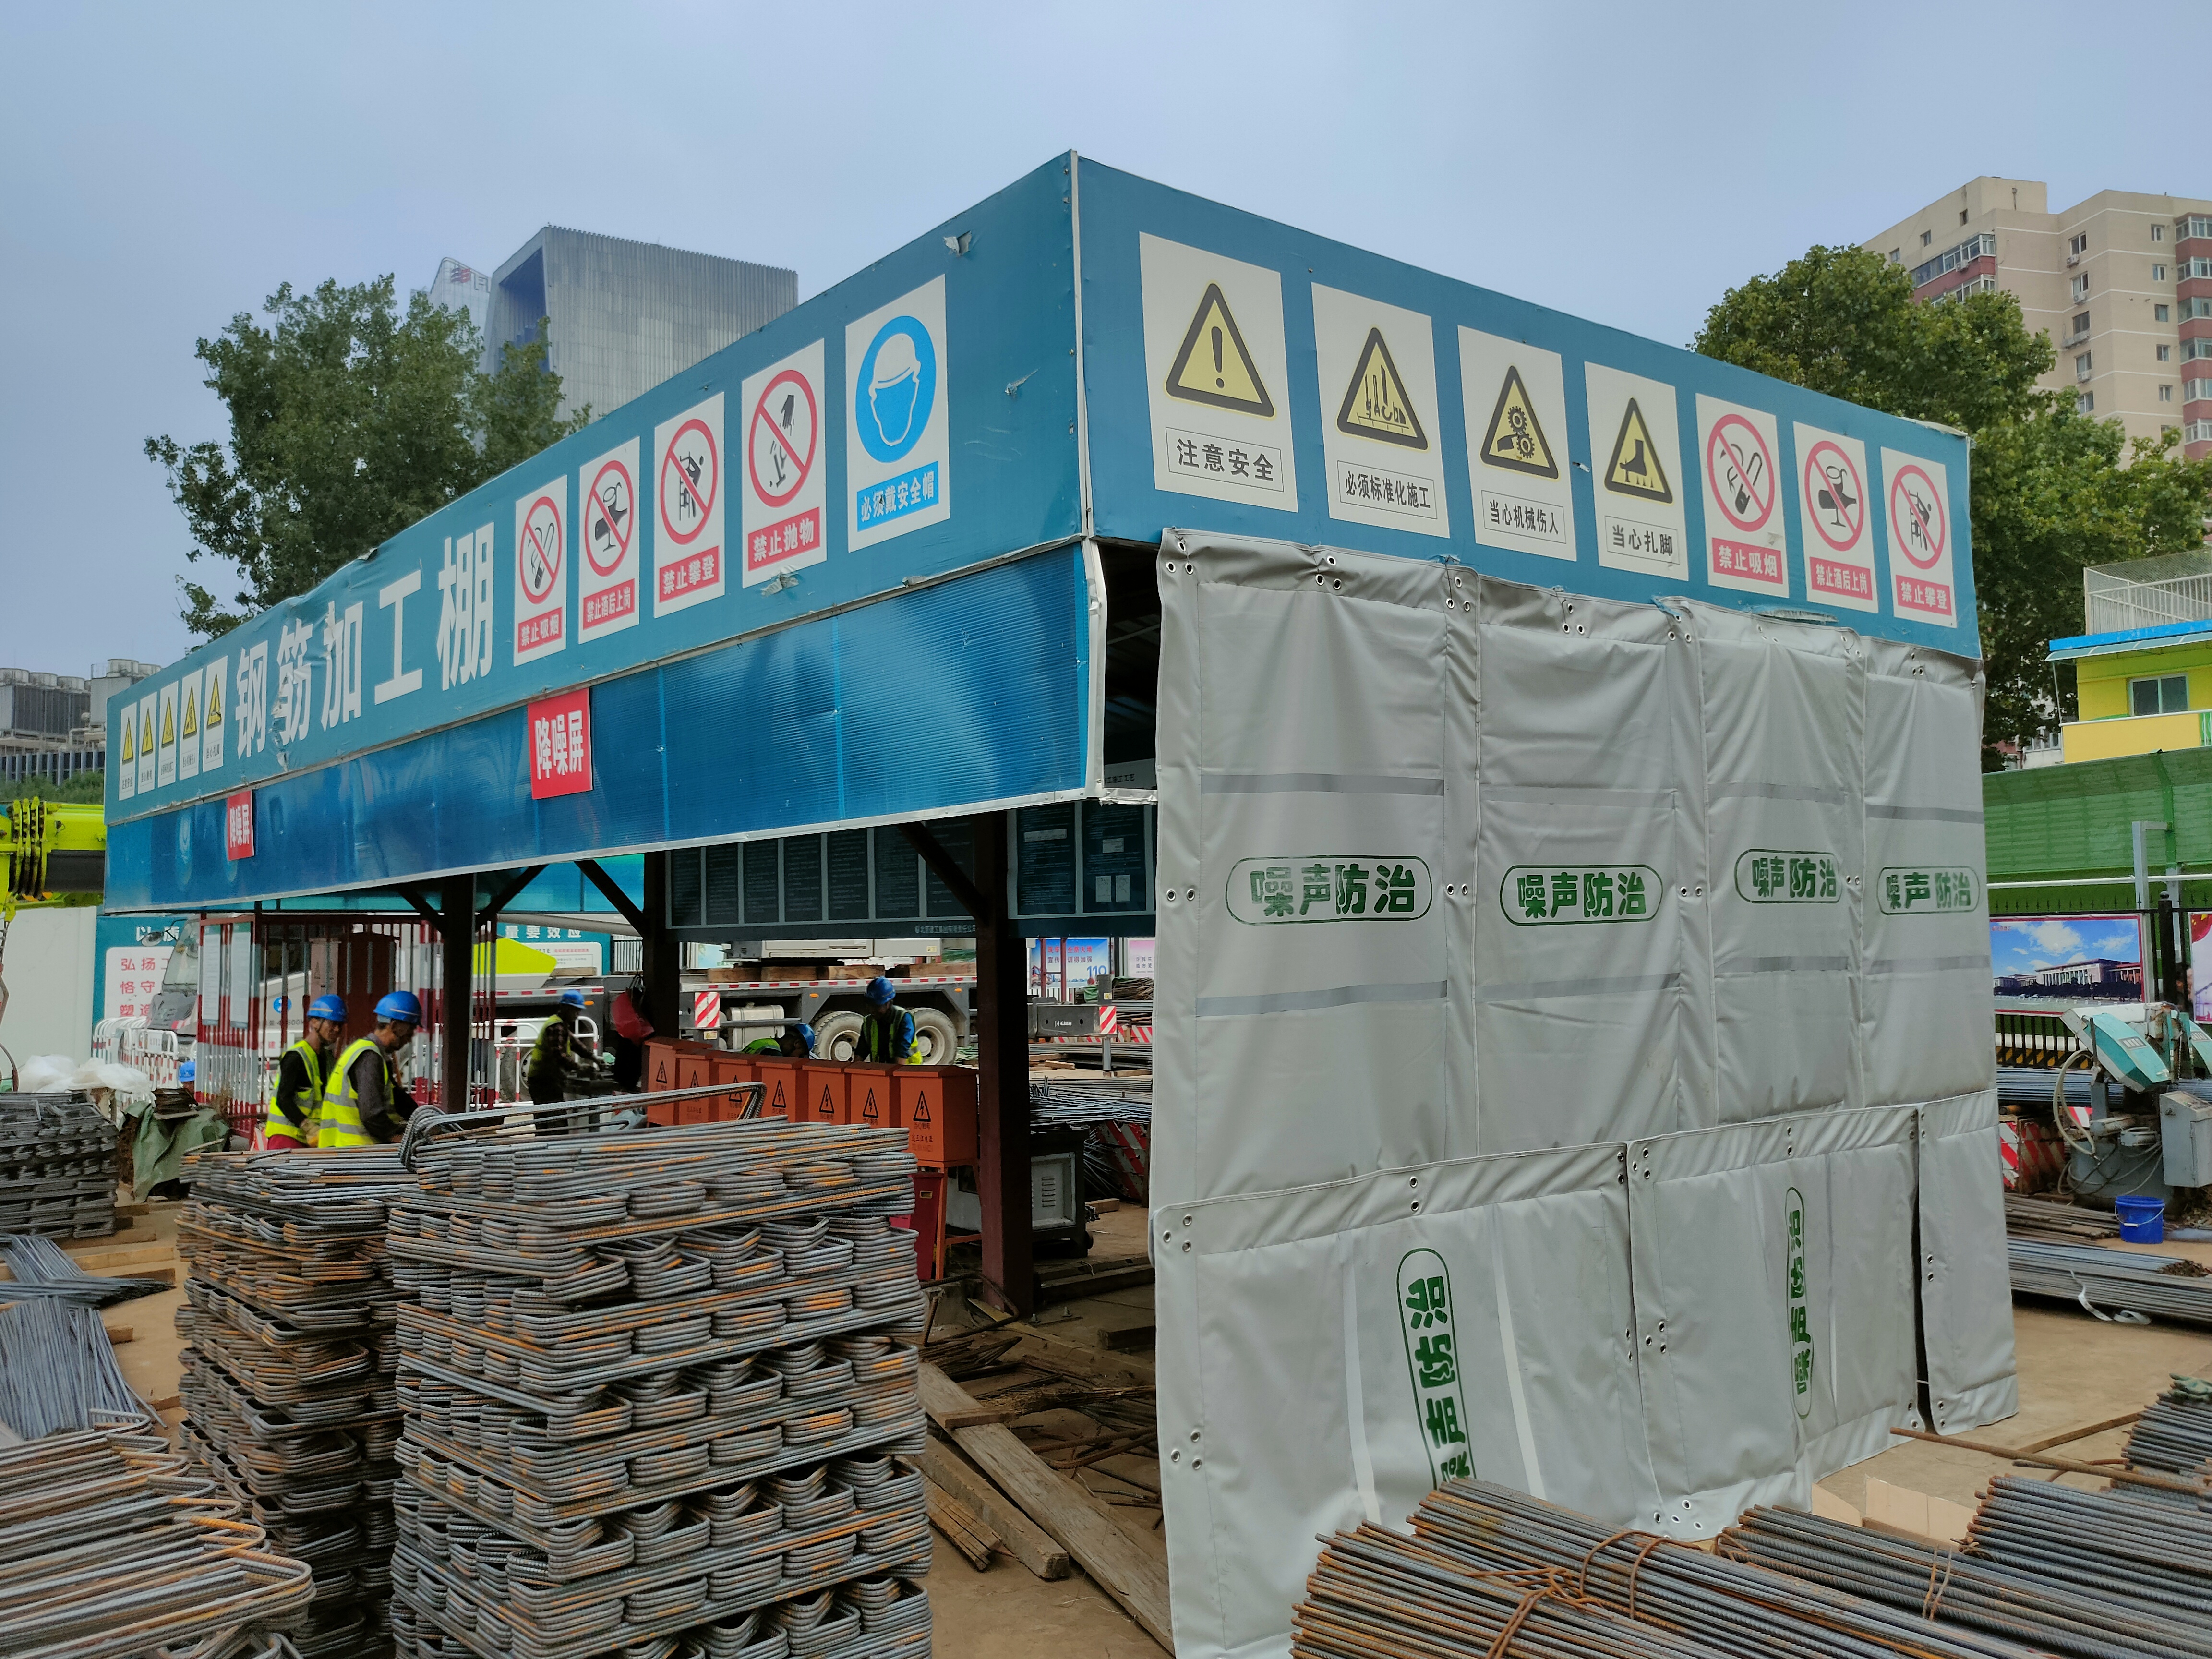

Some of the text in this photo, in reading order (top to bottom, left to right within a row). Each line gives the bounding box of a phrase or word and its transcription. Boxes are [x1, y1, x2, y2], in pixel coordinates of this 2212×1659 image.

[1177, 438, 1274, 482] 注意安全
[861, 470, 935, 522] 必须戴安全帽
[1345, 470, 1431, 510] 必须标准化施工
[1489, 499, 1560, 536] 当心机械伤人
[752, 518, 815, 563] 禁止抛物
[1611, 524, 1674, 557] 当心扎脚
[1718, 544, 1778, 578] 禁止吸烟
[662, 554, 715, 595] 禁止攀登
[1815, 563, 1868, 596] 禁止酒后上岗
[1899, 580, 1948, 610] 禁止攀登
[586, 586, 632, 623] 禁止酒后上岗
[235, 522, 494, 759] 钢筋加工棚
[520, 613, 560, 647] 禁止吸烟
[534, 709, 584, 781] 降噪屏
[229, 804, 250, 849] 降噪屏
[1250, 863, 1415, 918] 噪声防治
[1516, 871, 1646, 919] 噪声防治
[1751, 855, 1838, 898] 噪声防治
[1885, 871, 1971, 909] 噪声防治
[120, 980, 155, 994] 恪守
[1788, 1209, 1812, 1395] 噪声防治
